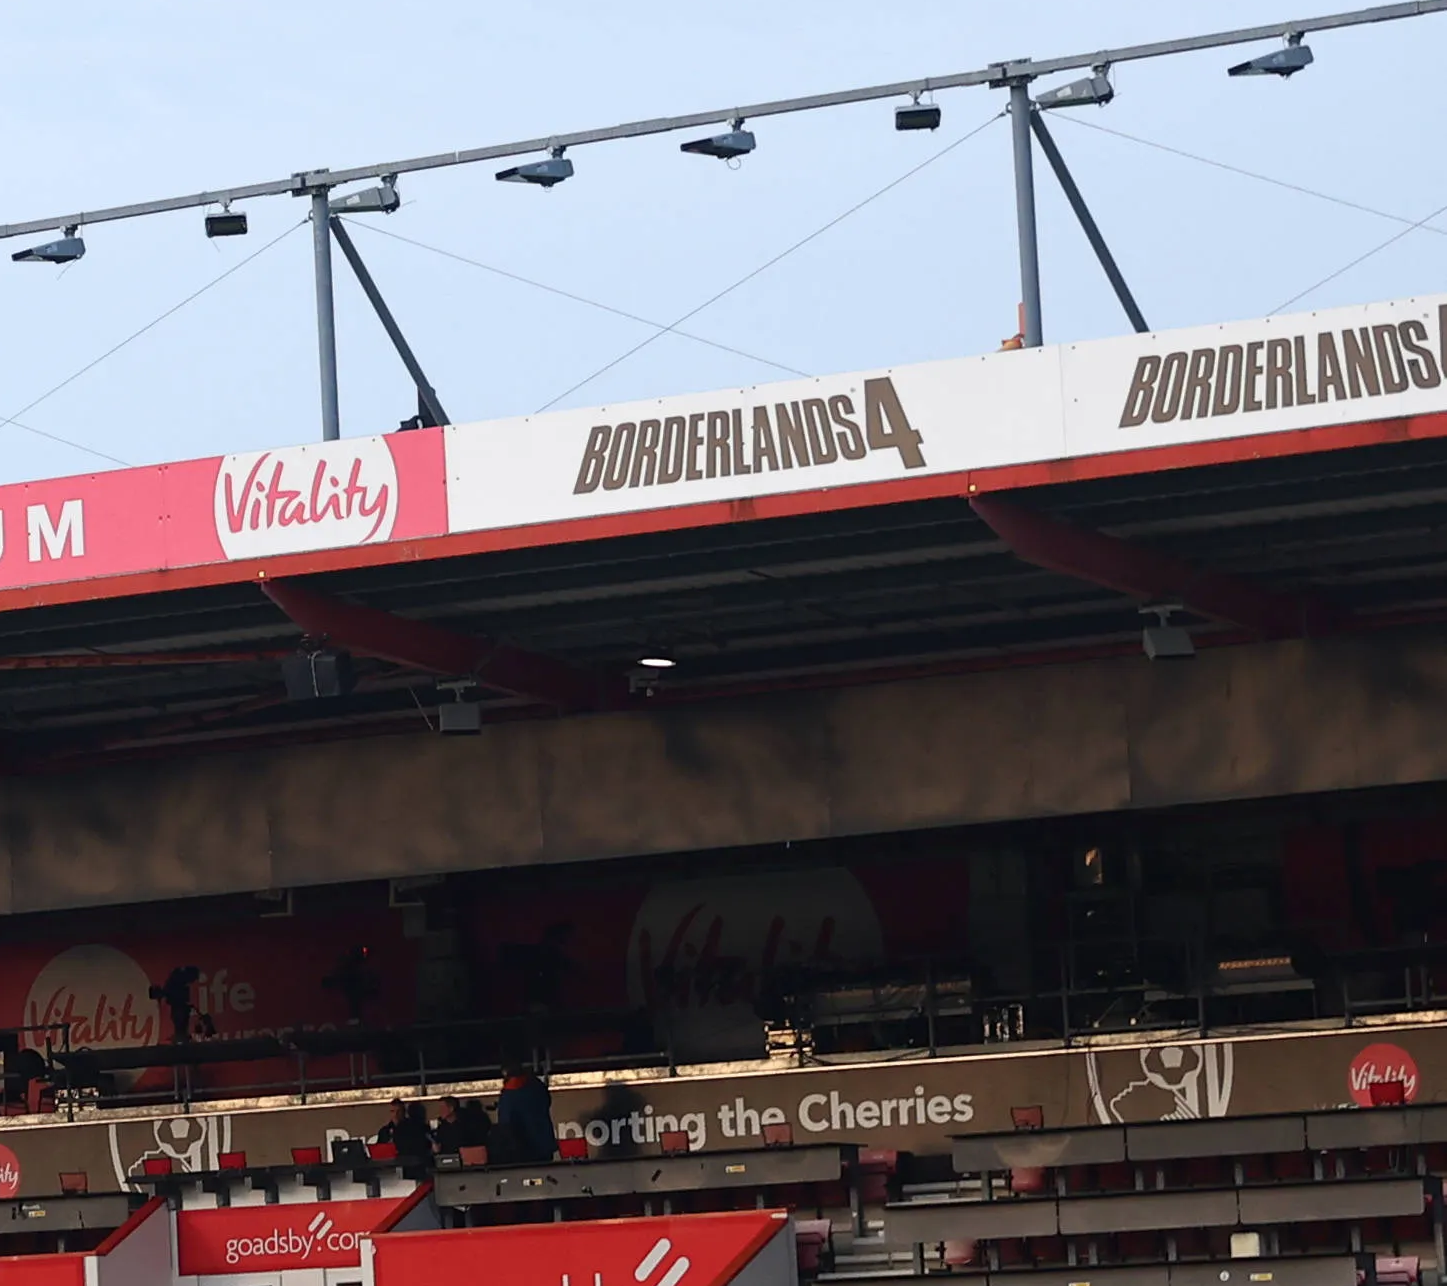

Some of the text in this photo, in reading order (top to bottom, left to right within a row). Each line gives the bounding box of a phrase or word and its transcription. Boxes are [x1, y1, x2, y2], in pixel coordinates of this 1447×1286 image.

[1118, 318, 1441, 429] BORDERLANDS
[572, 394, 868, 496] BORDERLANDS
[224, 452, 390, 543] Vitality
[31, 986, 154, 1047] Vitality
[554, 1086, 974, 1151] porting the Cherries
